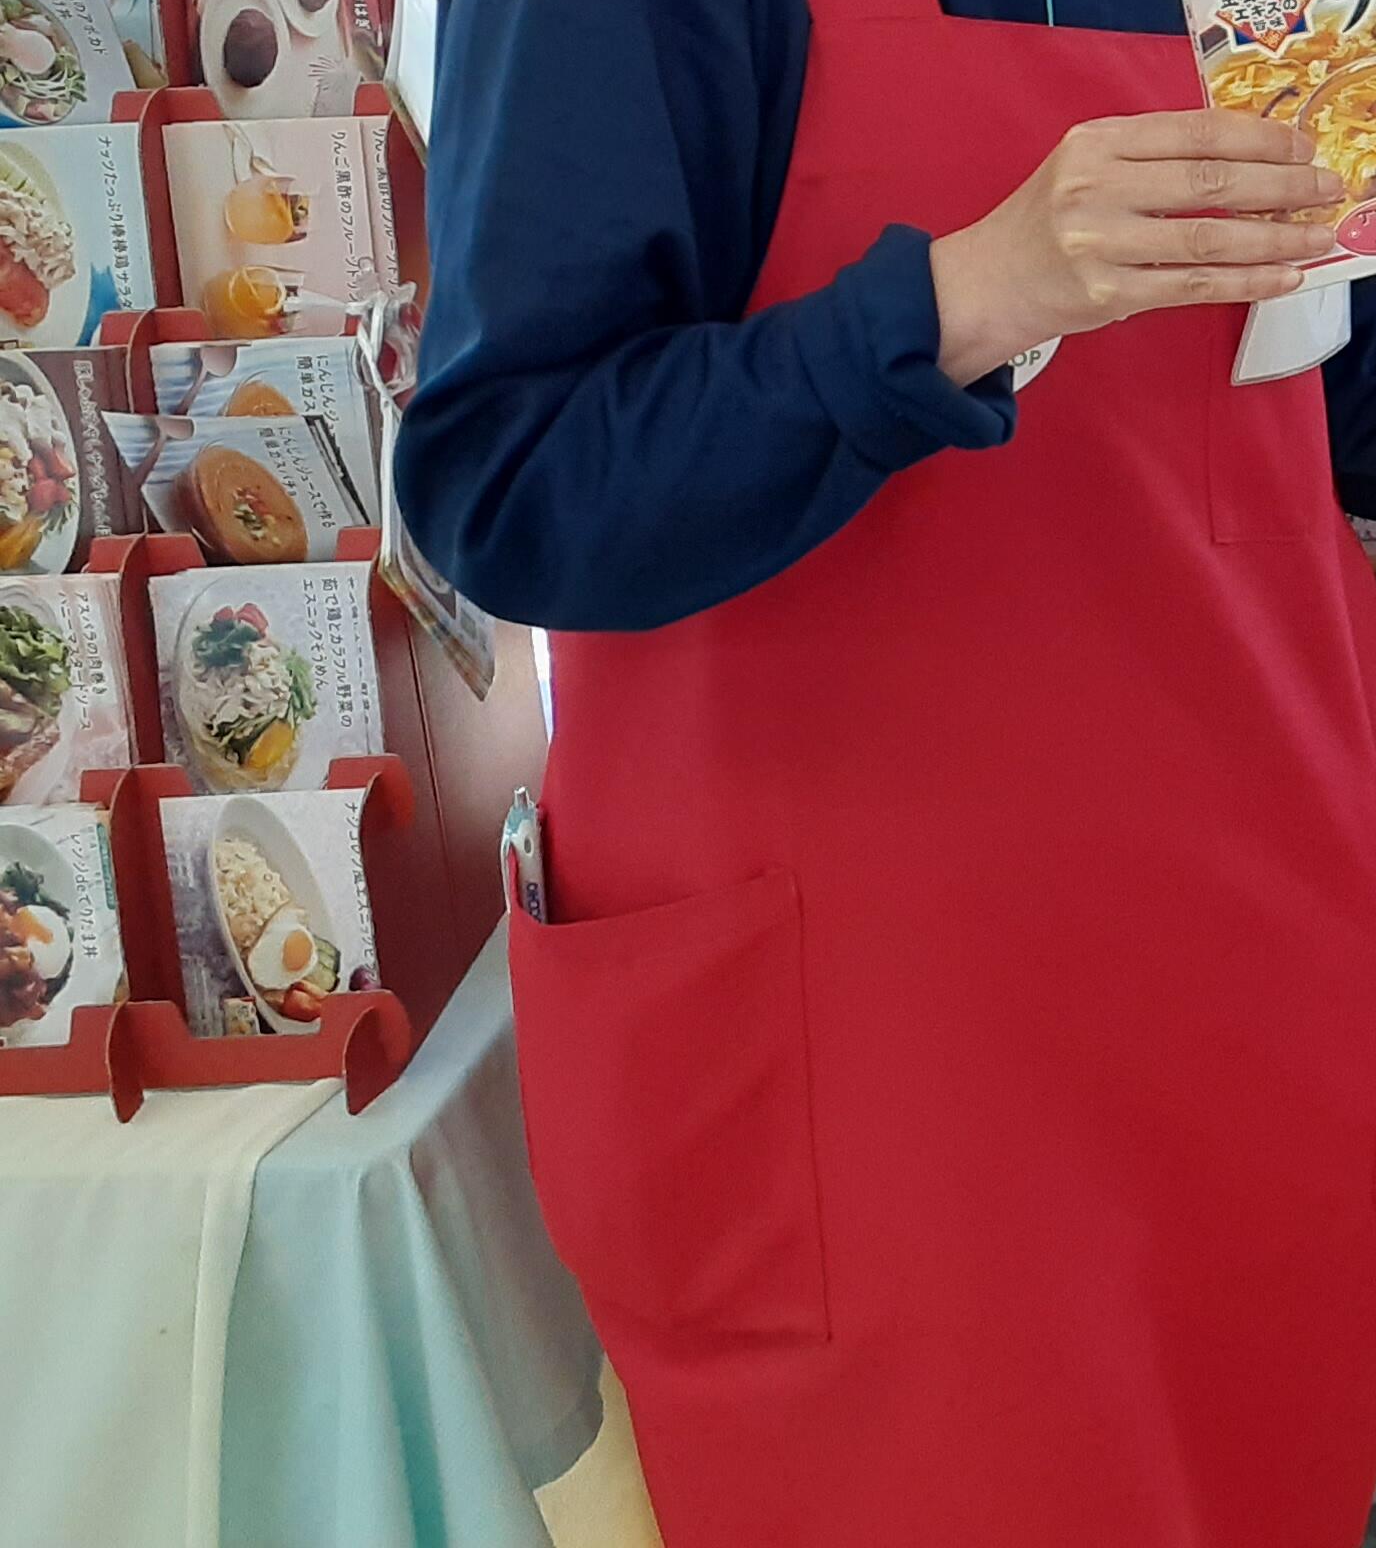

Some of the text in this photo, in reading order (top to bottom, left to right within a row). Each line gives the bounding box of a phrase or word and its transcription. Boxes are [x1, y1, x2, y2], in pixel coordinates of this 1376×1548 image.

[303, 579, 329, 690] エスニックそうめん
